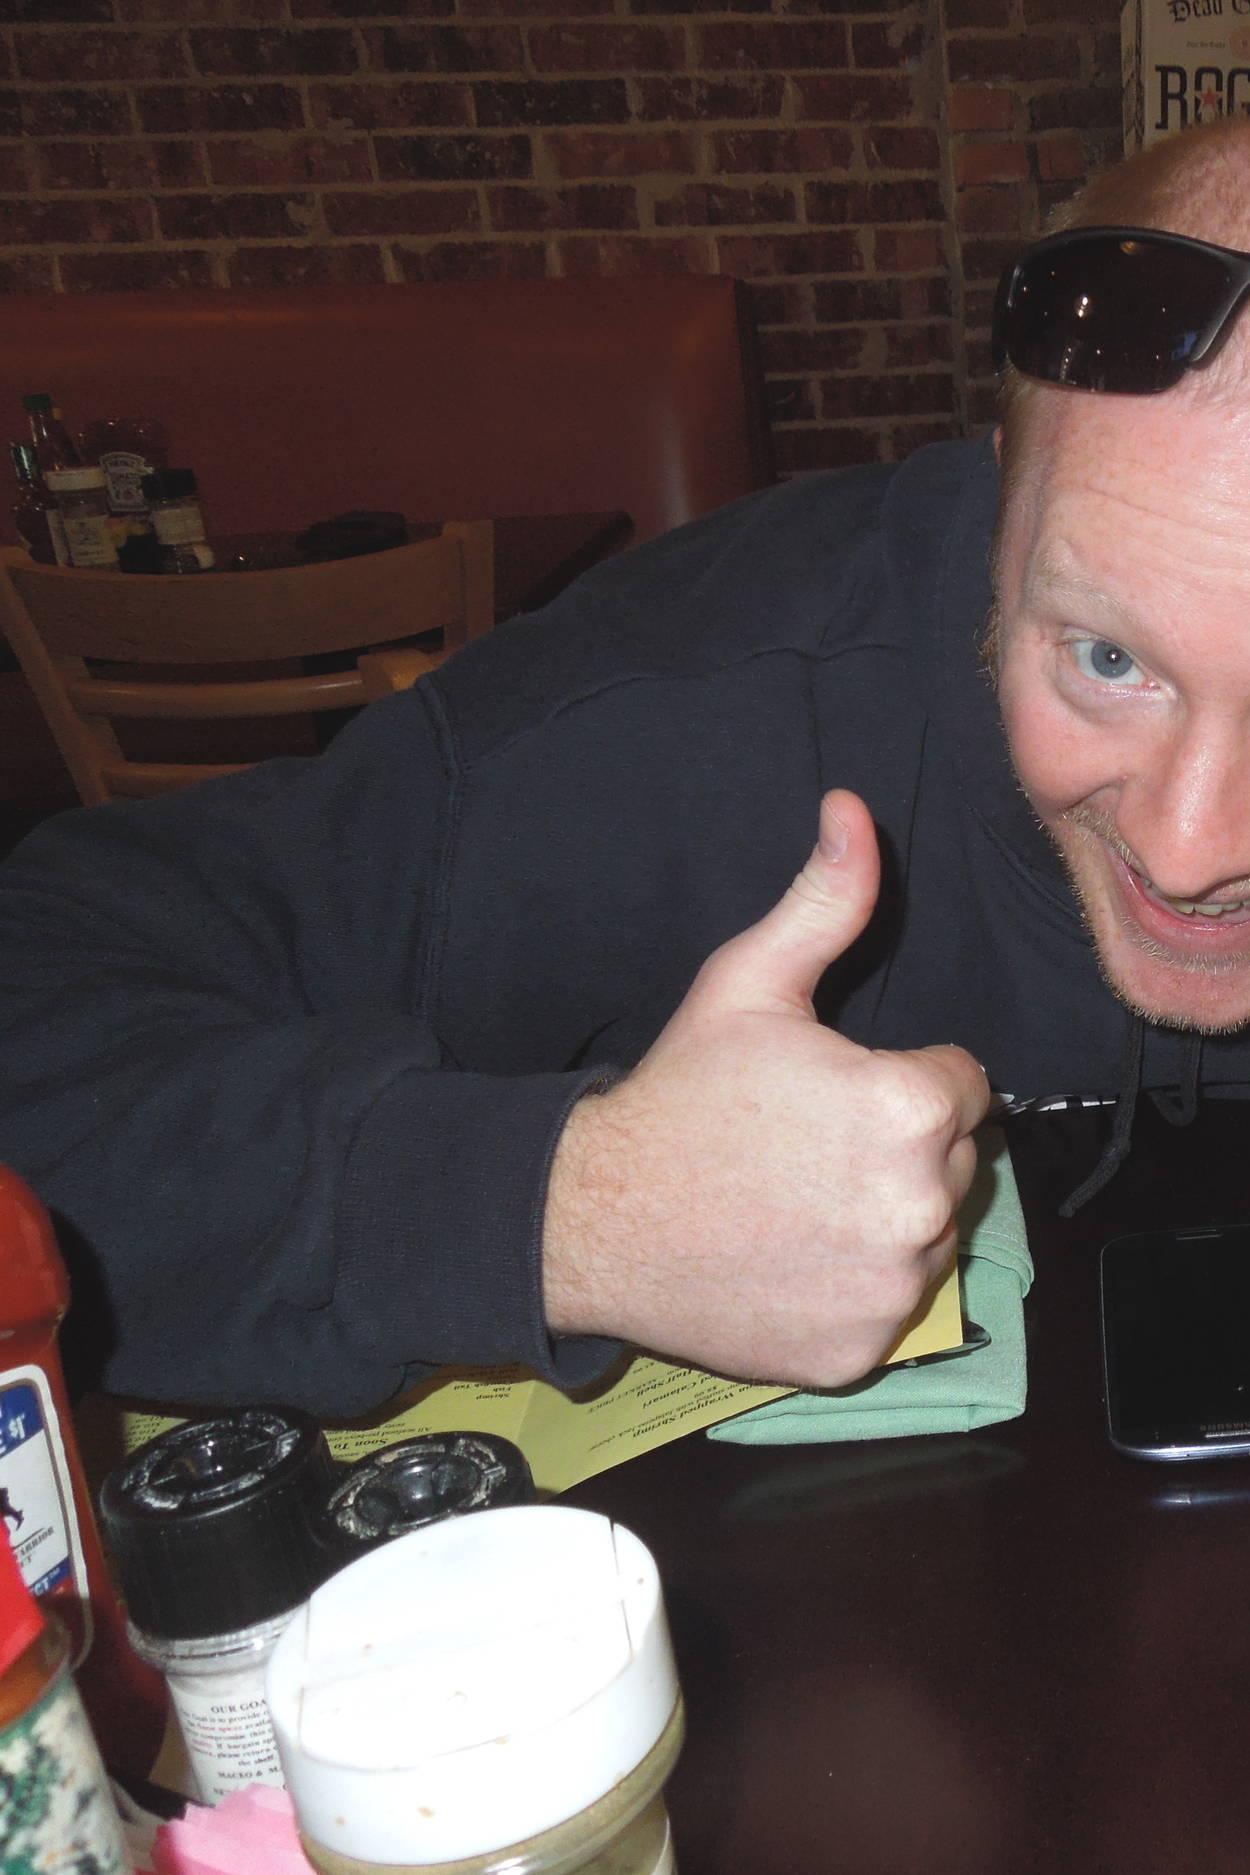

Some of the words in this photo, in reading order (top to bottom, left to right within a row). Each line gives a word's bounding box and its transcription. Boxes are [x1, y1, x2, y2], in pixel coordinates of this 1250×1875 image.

[642, 1382, 697, 1409] Calamari
[680, 1392, 734, 1419] Wrapped
[633, 1415, 676, 1438] Shrimp
[354, 1438, 389, 1447] Soon
[15, 1527, 55, 1558] ARRIOR
[210, 1704, 238, 1714] OUR
[228, 1712, 261, 1724] provide
